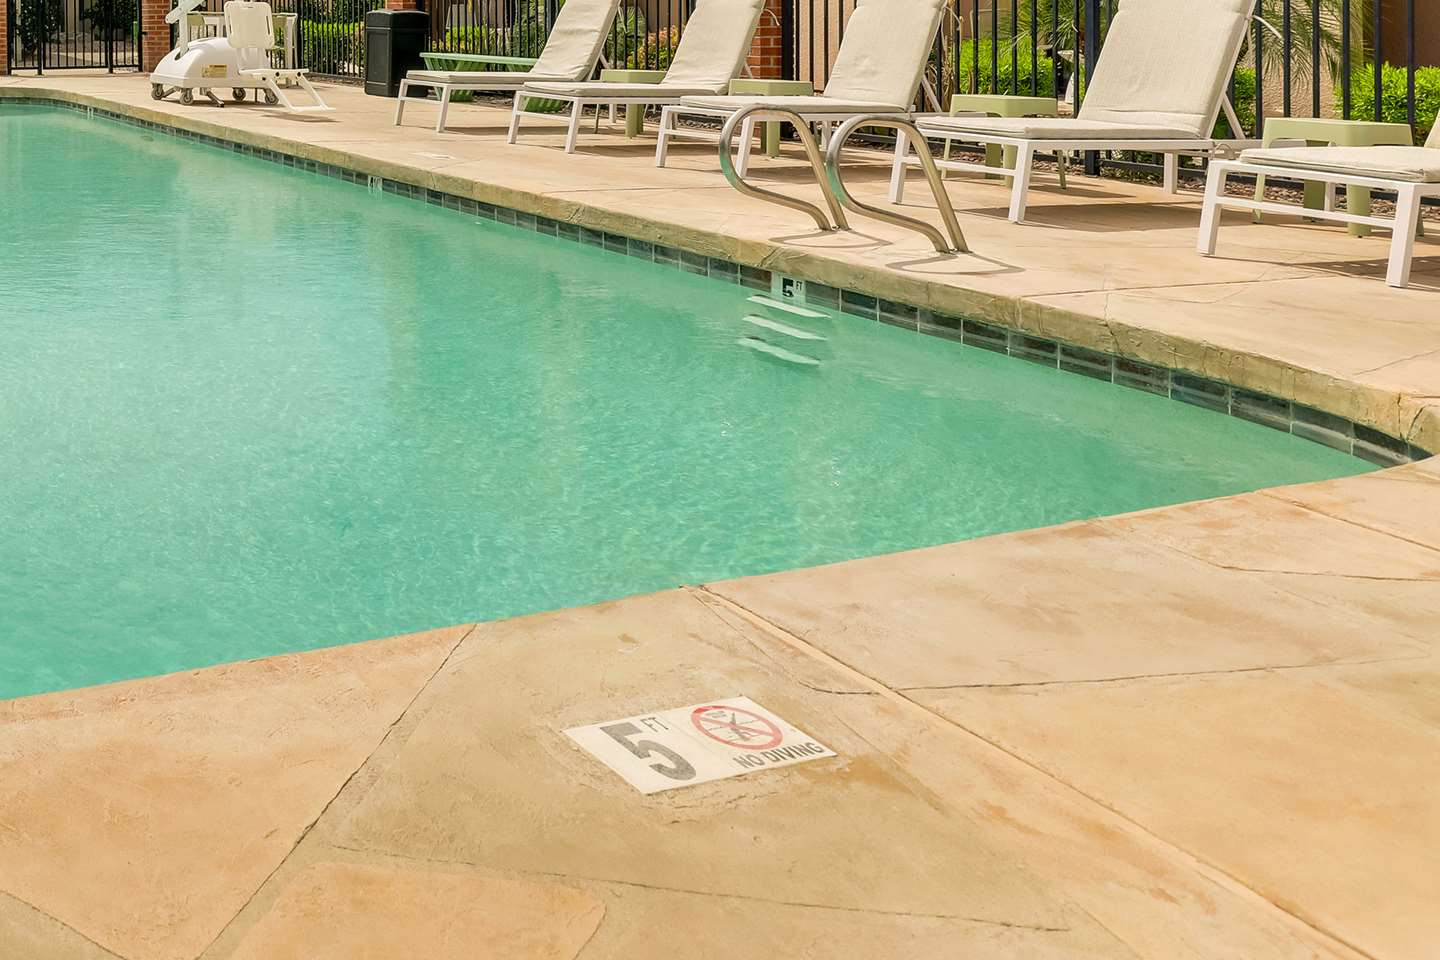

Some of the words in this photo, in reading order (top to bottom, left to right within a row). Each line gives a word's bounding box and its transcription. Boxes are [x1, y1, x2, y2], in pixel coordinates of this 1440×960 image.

[640, 716, 669, 733] FT
[600, 722, 696, 781] 5
[732, 753, 765, 769] NO
[760, 742, 825, 763] DIVING
